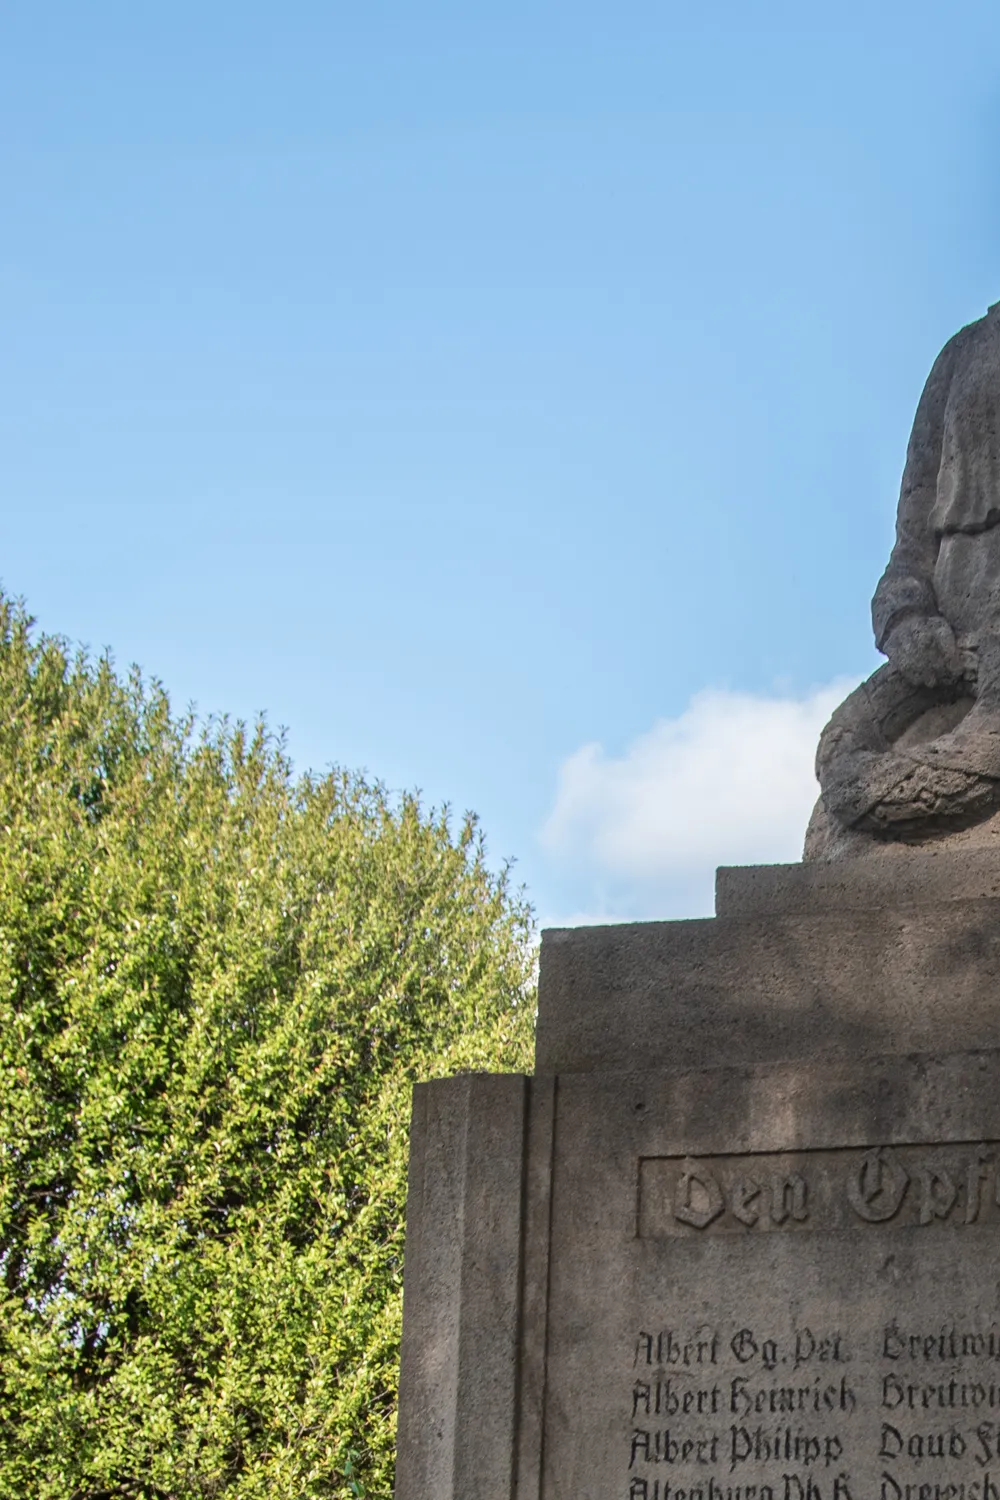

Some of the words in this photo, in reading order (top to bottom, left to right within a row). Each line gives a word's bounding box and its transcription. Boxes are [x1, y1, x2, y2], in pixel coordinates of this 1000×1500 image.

[672, 1154, 810, 1231] Den
[633, 1330, 718, 1369] Albert
[632, 1378, 720, 1418] Albert
[731, 1376, 856, 1420] Heinrich
[628, 1428, 719, 1471] Albert
[730, 1421, 843, 1473] Philipp
[879, 1422, 967, 1459] Daub
